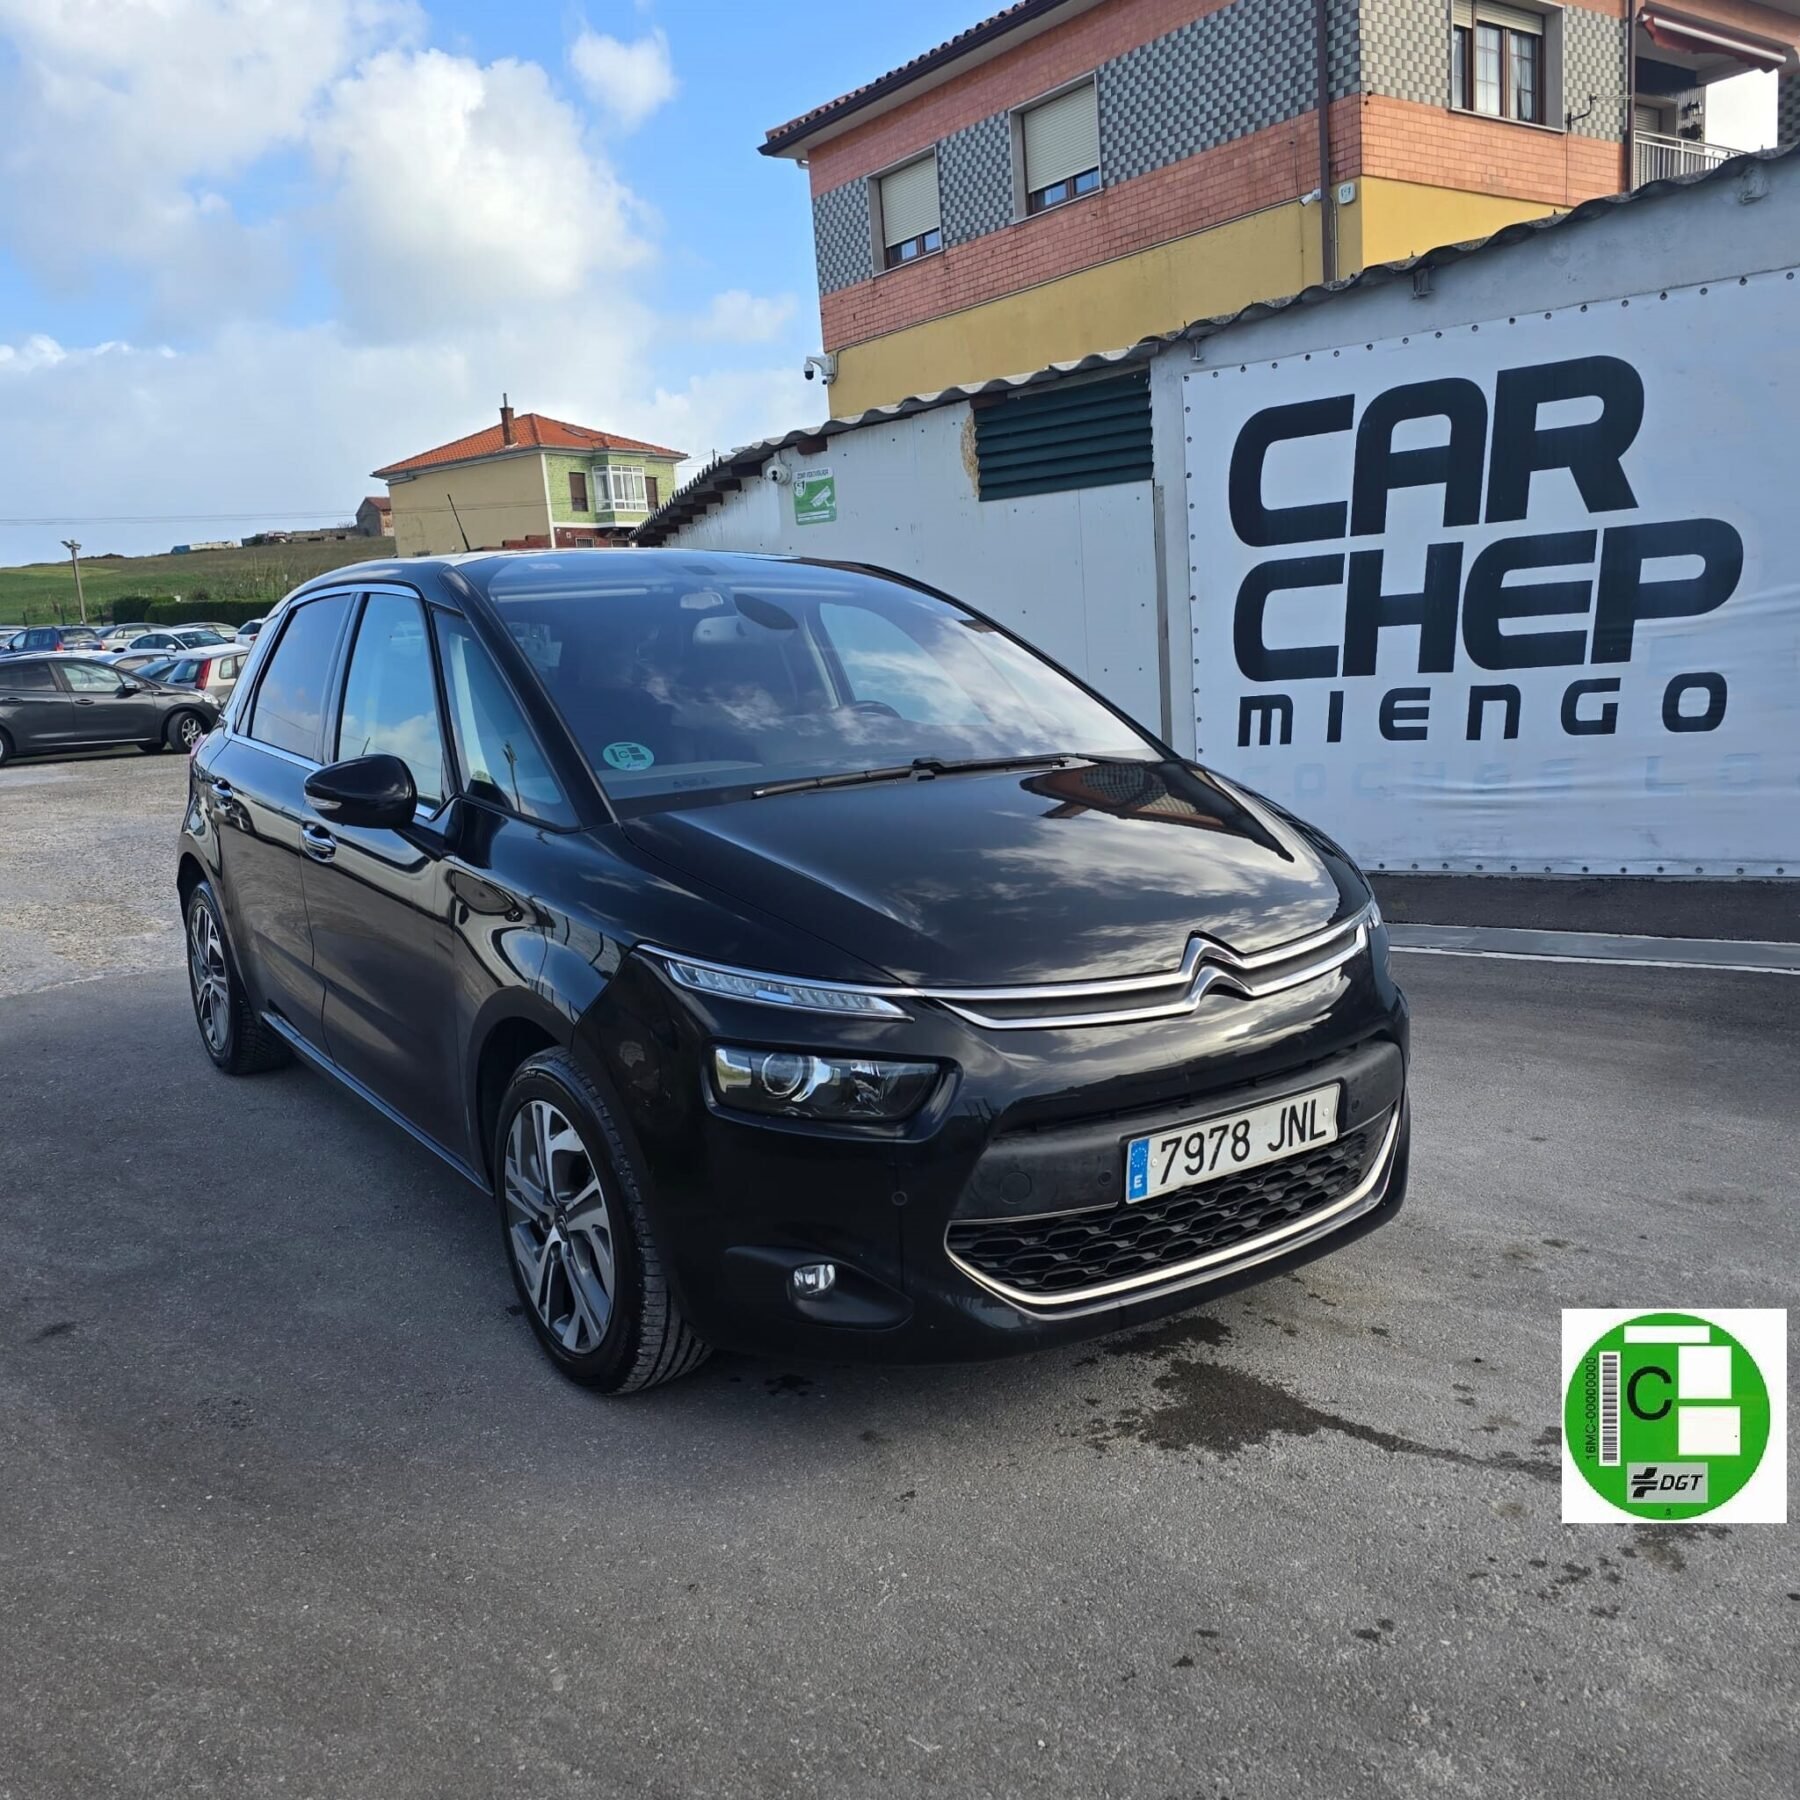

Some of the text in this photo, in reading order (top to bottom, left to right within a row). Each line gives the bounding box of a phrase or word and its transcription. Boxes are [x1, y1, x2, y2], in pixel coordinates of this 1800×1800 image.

[1229, 355, 1645, 547] CAR
[1233, 518, 1743, 682] CHEP
[1237, 672, 1728, 747] MIENGO
[1133, 1175, 1143, 1189] E
[1160, 1099, 1327, 1185] 7978 JNL
